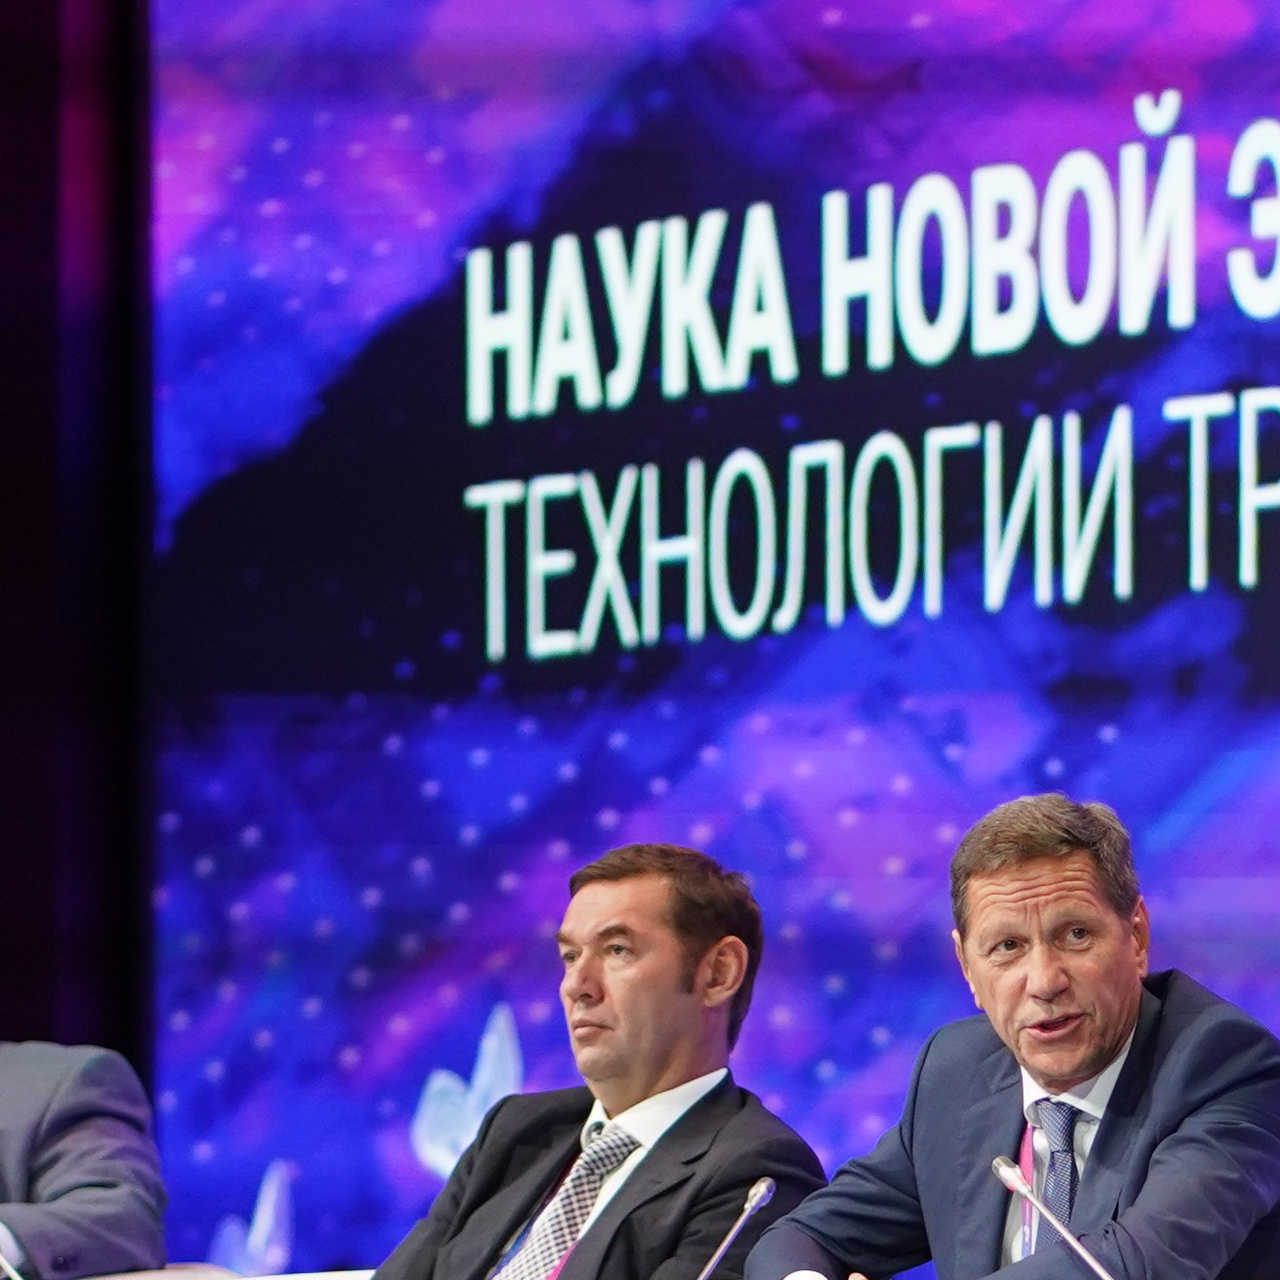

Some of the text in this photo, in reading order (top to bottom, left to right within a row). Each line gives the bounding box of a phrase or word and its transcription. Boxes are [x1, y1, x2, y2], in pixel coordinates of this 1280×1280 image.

[464, 201, 800, 428] НАУКА
[821, 88, 1197, 378] НОВОЙ
[463, 403, 1135, 664] ТЕХНОЛОГИИ
